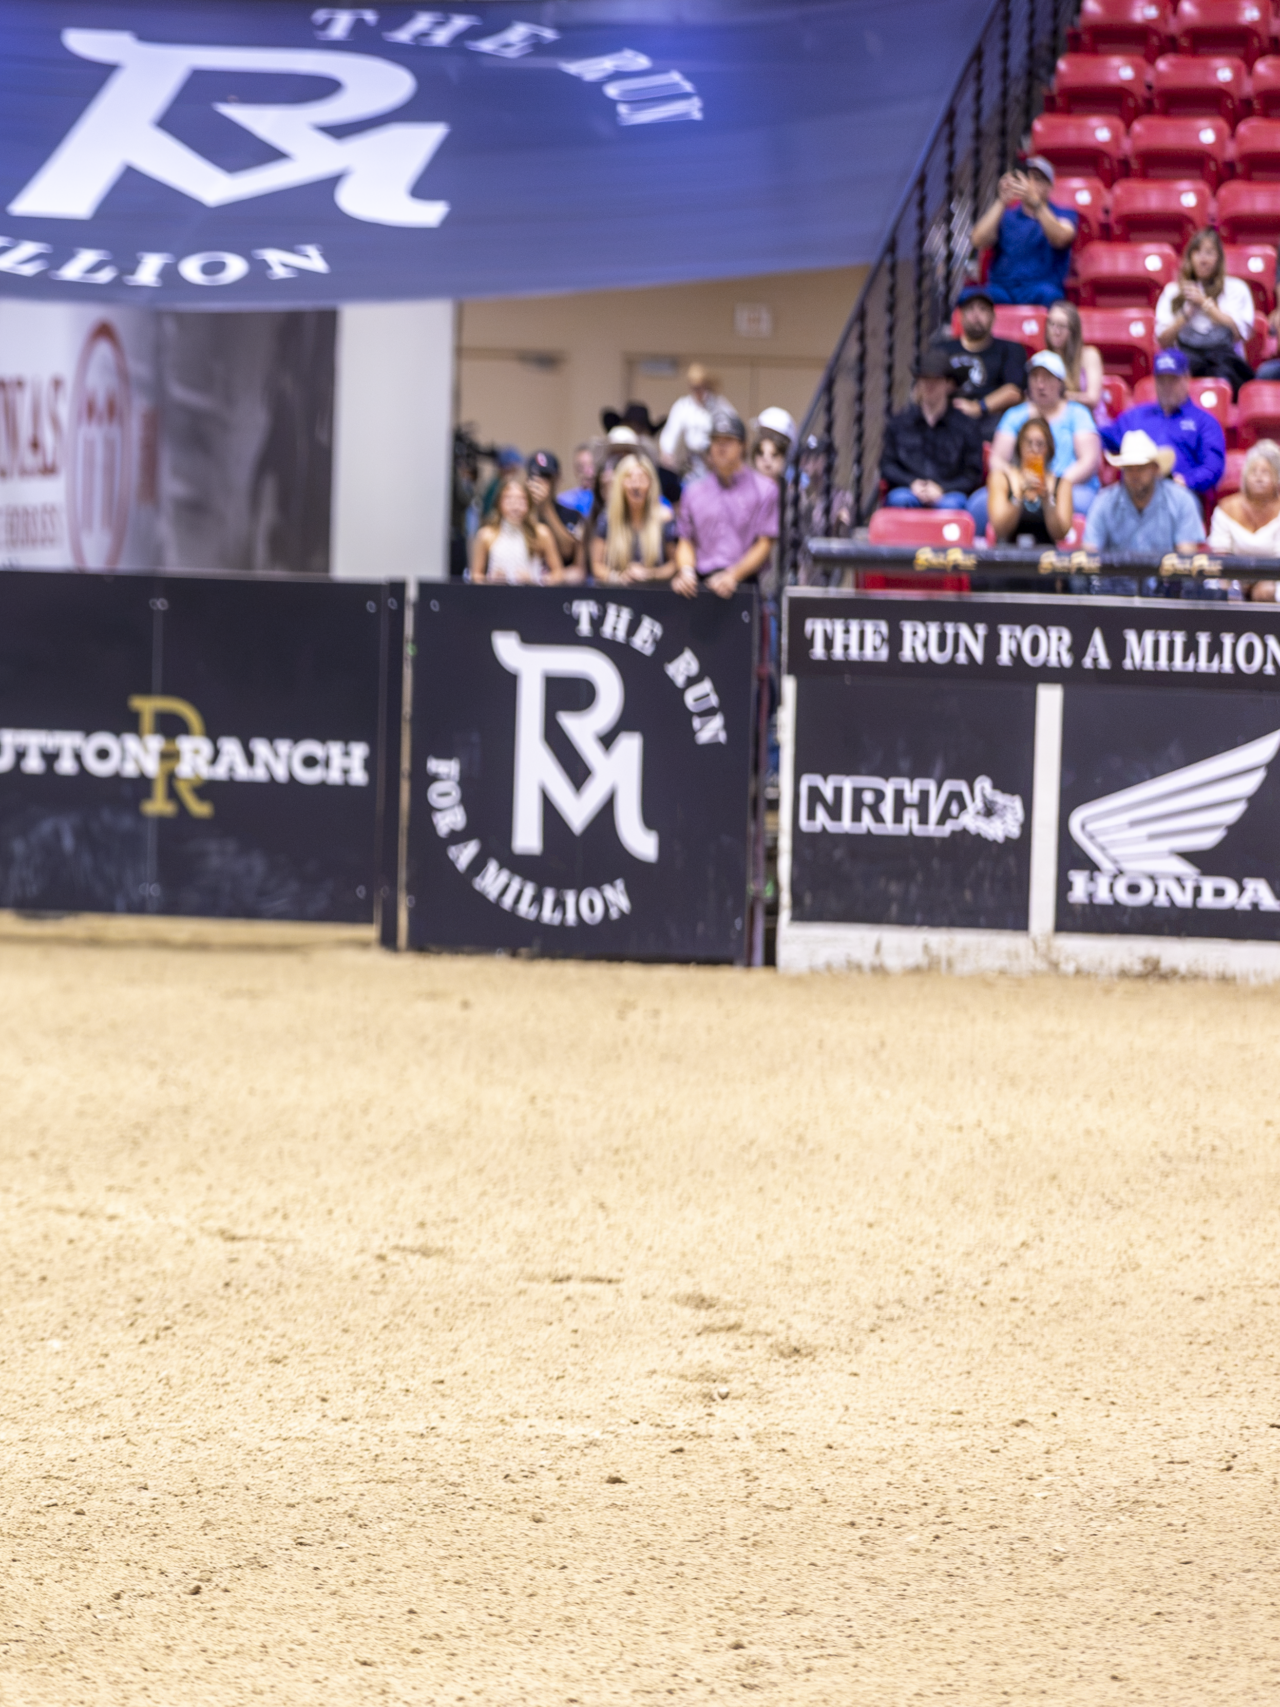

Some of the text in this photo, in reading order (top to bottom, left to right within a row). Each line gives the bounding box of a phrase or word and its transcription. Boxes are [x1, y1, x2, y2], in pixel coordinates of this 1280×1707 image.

[311, 8, 704, 126] THE RUN
[571, 599, 728, 745] THE RUN
[805, 617, 889, 662] THE
[899, 620, 987, 665] RUN
[996, 624, 1074, 669] FOR
[1082, 626, 1111, 670] A
[173, 734, 370, 787] RANCH
[799, 772, 972, 838] NRHA
[426, 755, 632, 926] FOR A MILLION
[1067, 869, 1280, 913] HONDA
